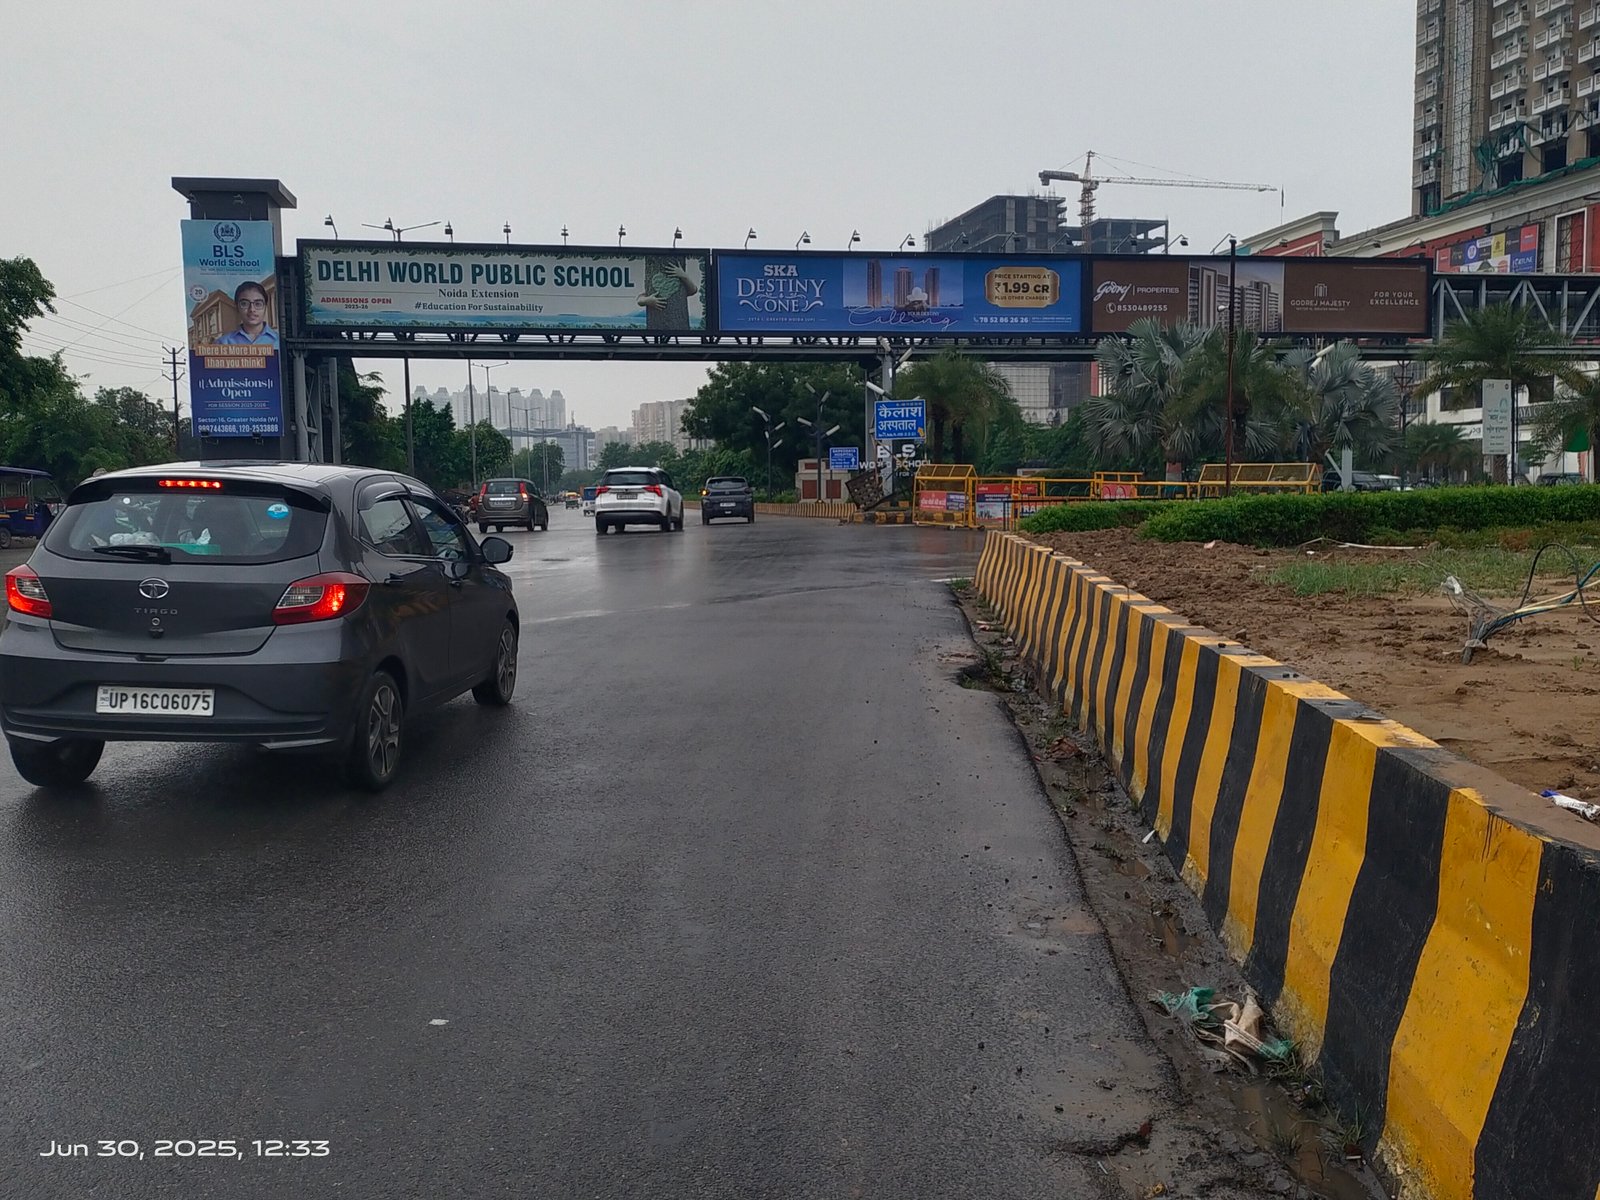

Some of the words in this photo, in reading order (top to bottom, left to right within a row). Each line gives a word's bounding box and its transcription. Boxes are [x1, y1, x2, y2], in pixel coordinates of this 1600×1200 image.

[213, 245, 245, 258] BLS
[199, 259, 227, 267] World
[228, 259, 260, 267] School
[317, 260, 380, 282] DELHI
[387, 261, 463, 285] WORLD
[471, 263, 546, 286] PUBLIC
[553, 265, 635, 288] SCHOOL
[763, 265, 799, 277] SKA
[736, 278, 826, 298] DESTINY
[994, 282, 1030, 293] ₹1.99
[1033, 285, 1050, 293] CR
[1136, 286, 1180, 294] PROPERTIES
[438, 289, 468, 298] Noida
[471, 289, 520, 299] Extension
[414, 302, 467, 311] #Education
[483, 304, 544, 313] Sustainability
[764, 299, 800, 312] ONE
[1116, 304, 1168, 312] 8530489255
[848, 305, 958, 331] Calling
[198, 346, 219, 355] There
[228, 346, 248, 355] More
[257, 346, 272, 356] you
[207, 358, 225, 367] than
[226, 359, 240, 368] you
[241, 358, 263, 367] think!
[205, 378, 268, 388] Admissions
[221, 388, 252, 399] Open
[877, 404, 923, 419] कैलाश
[877, 419, 917, 431] अस्पताल
[133, 607, 178, 615] TIAGO
[109, 692, 211, 711] UP16CQ6075
